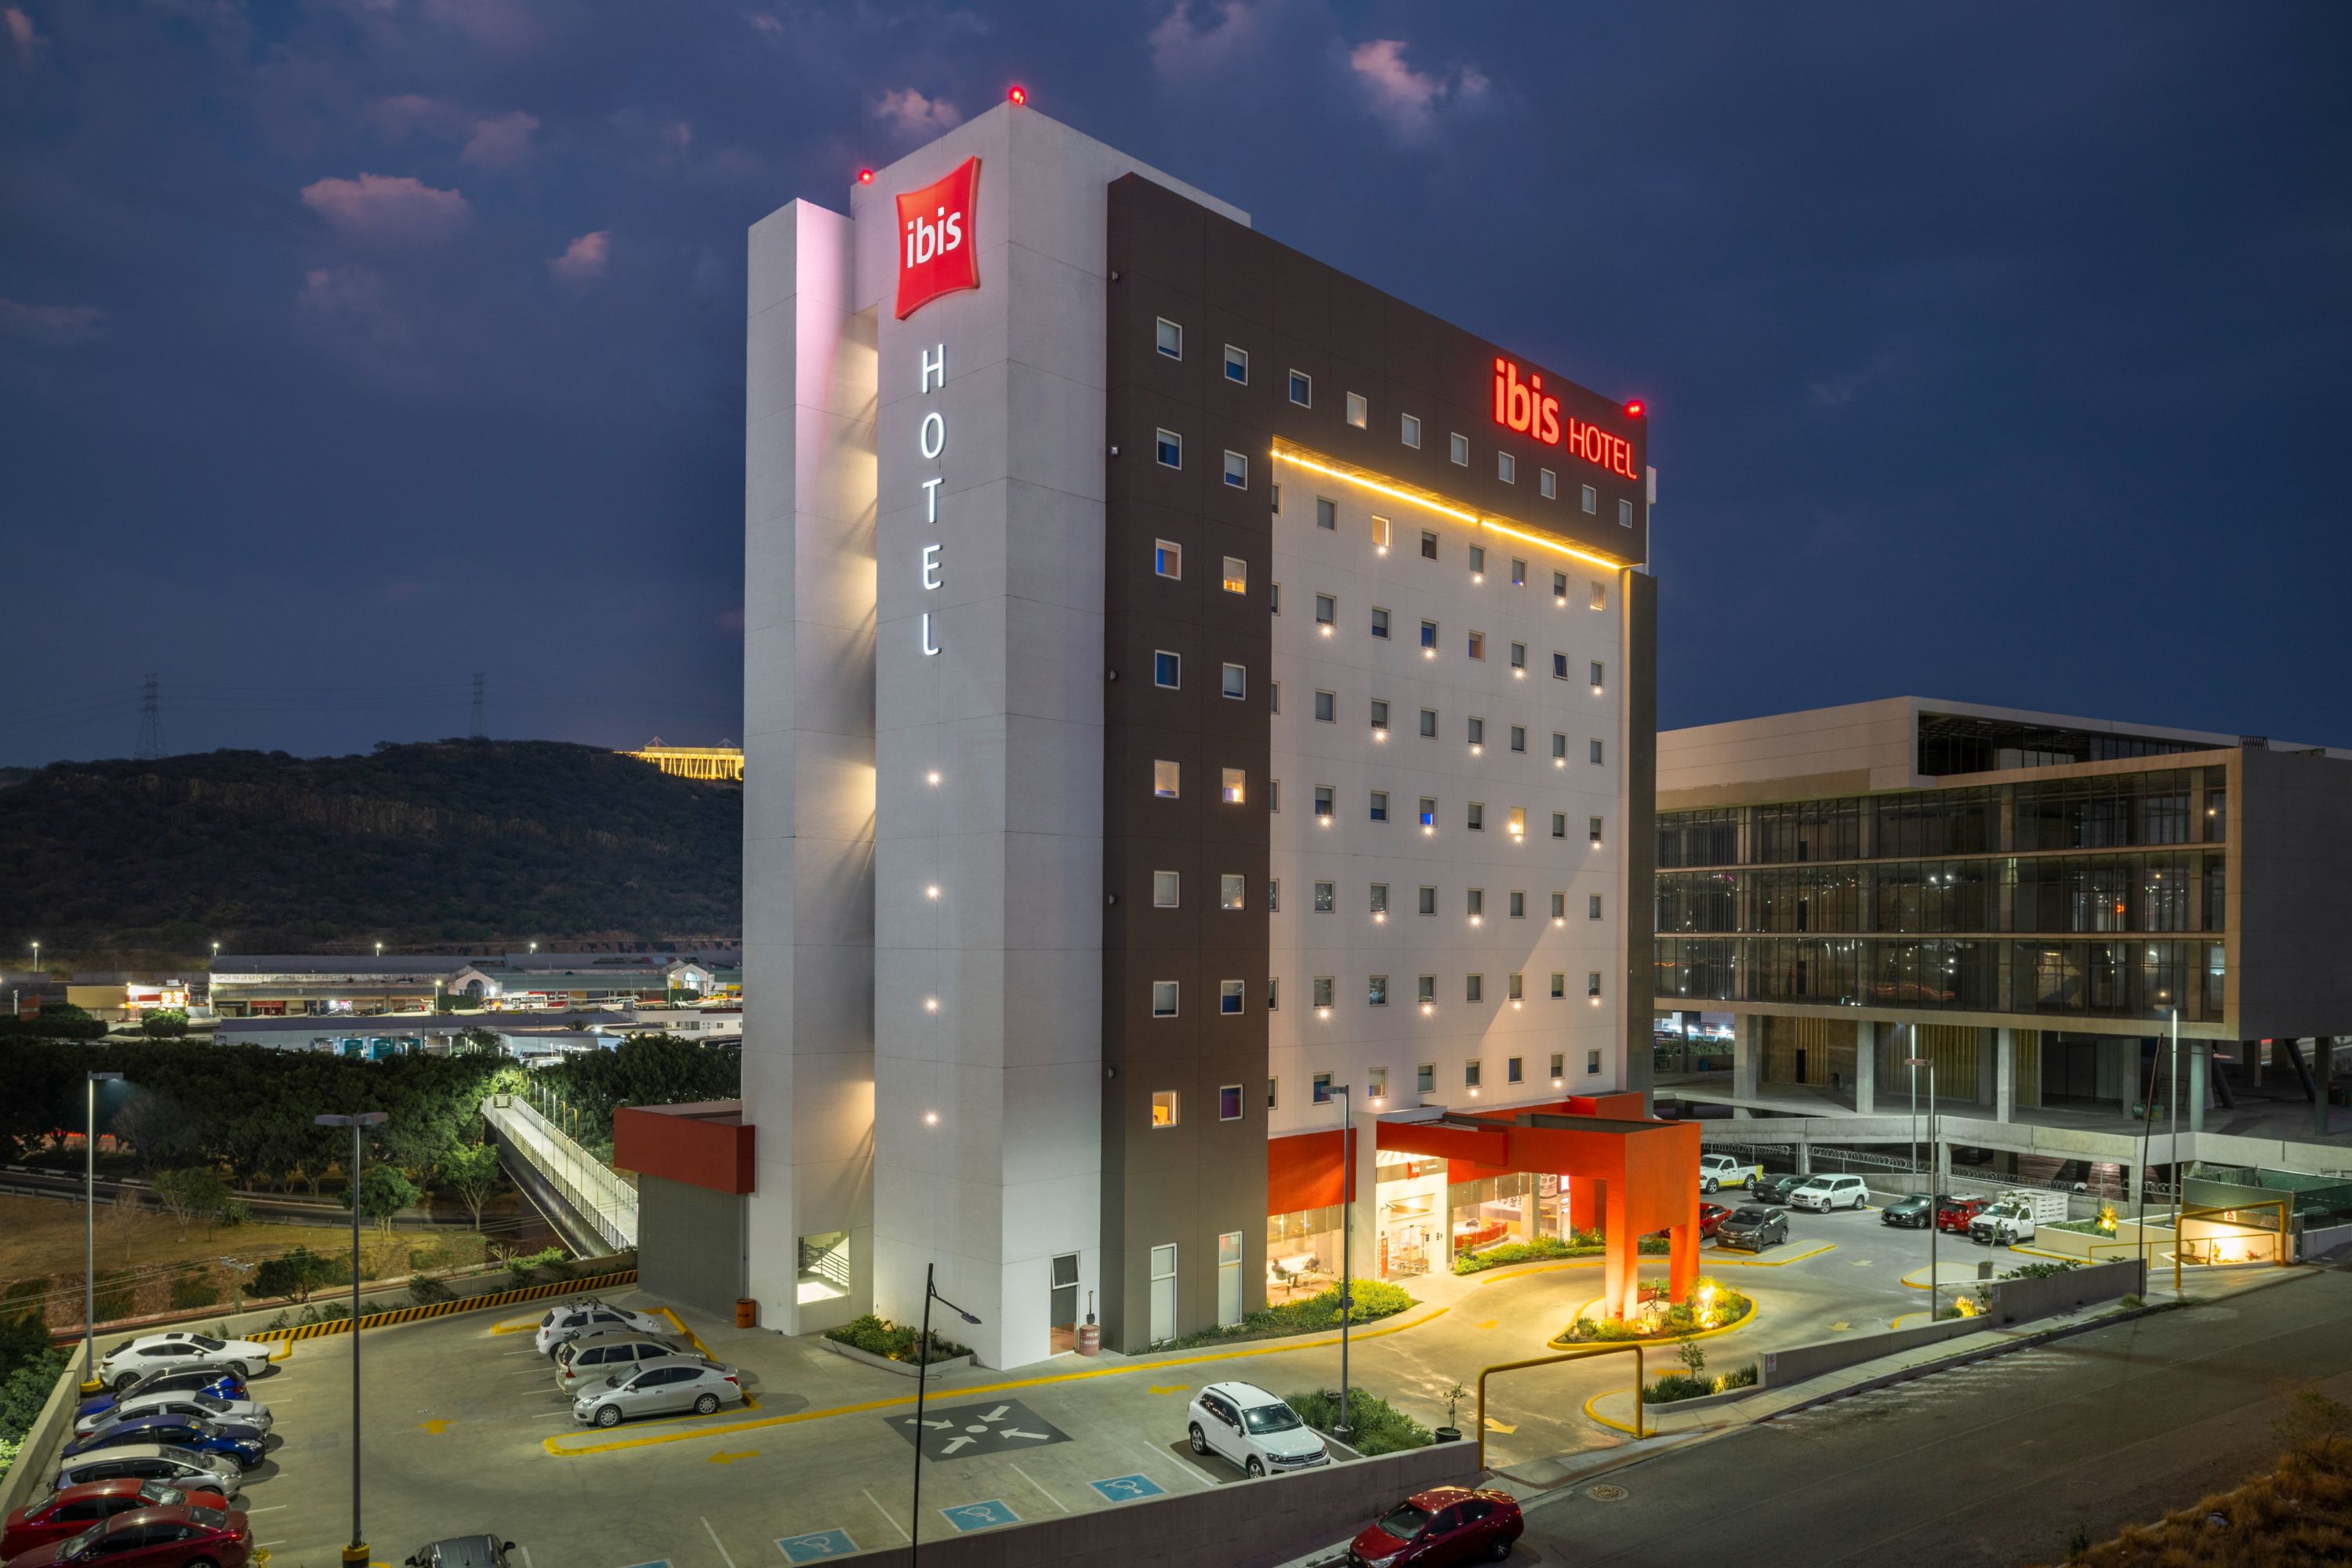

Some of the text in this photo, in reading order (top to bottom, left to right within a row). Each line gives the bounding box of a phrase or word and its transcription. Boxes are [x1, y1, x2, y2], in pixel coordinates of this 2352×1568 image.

[907, 206, 962, 268] ibis
[1495, 358, 1638, 480] ibis HOTEL
[921, 343, 946, 655] HOTEL
